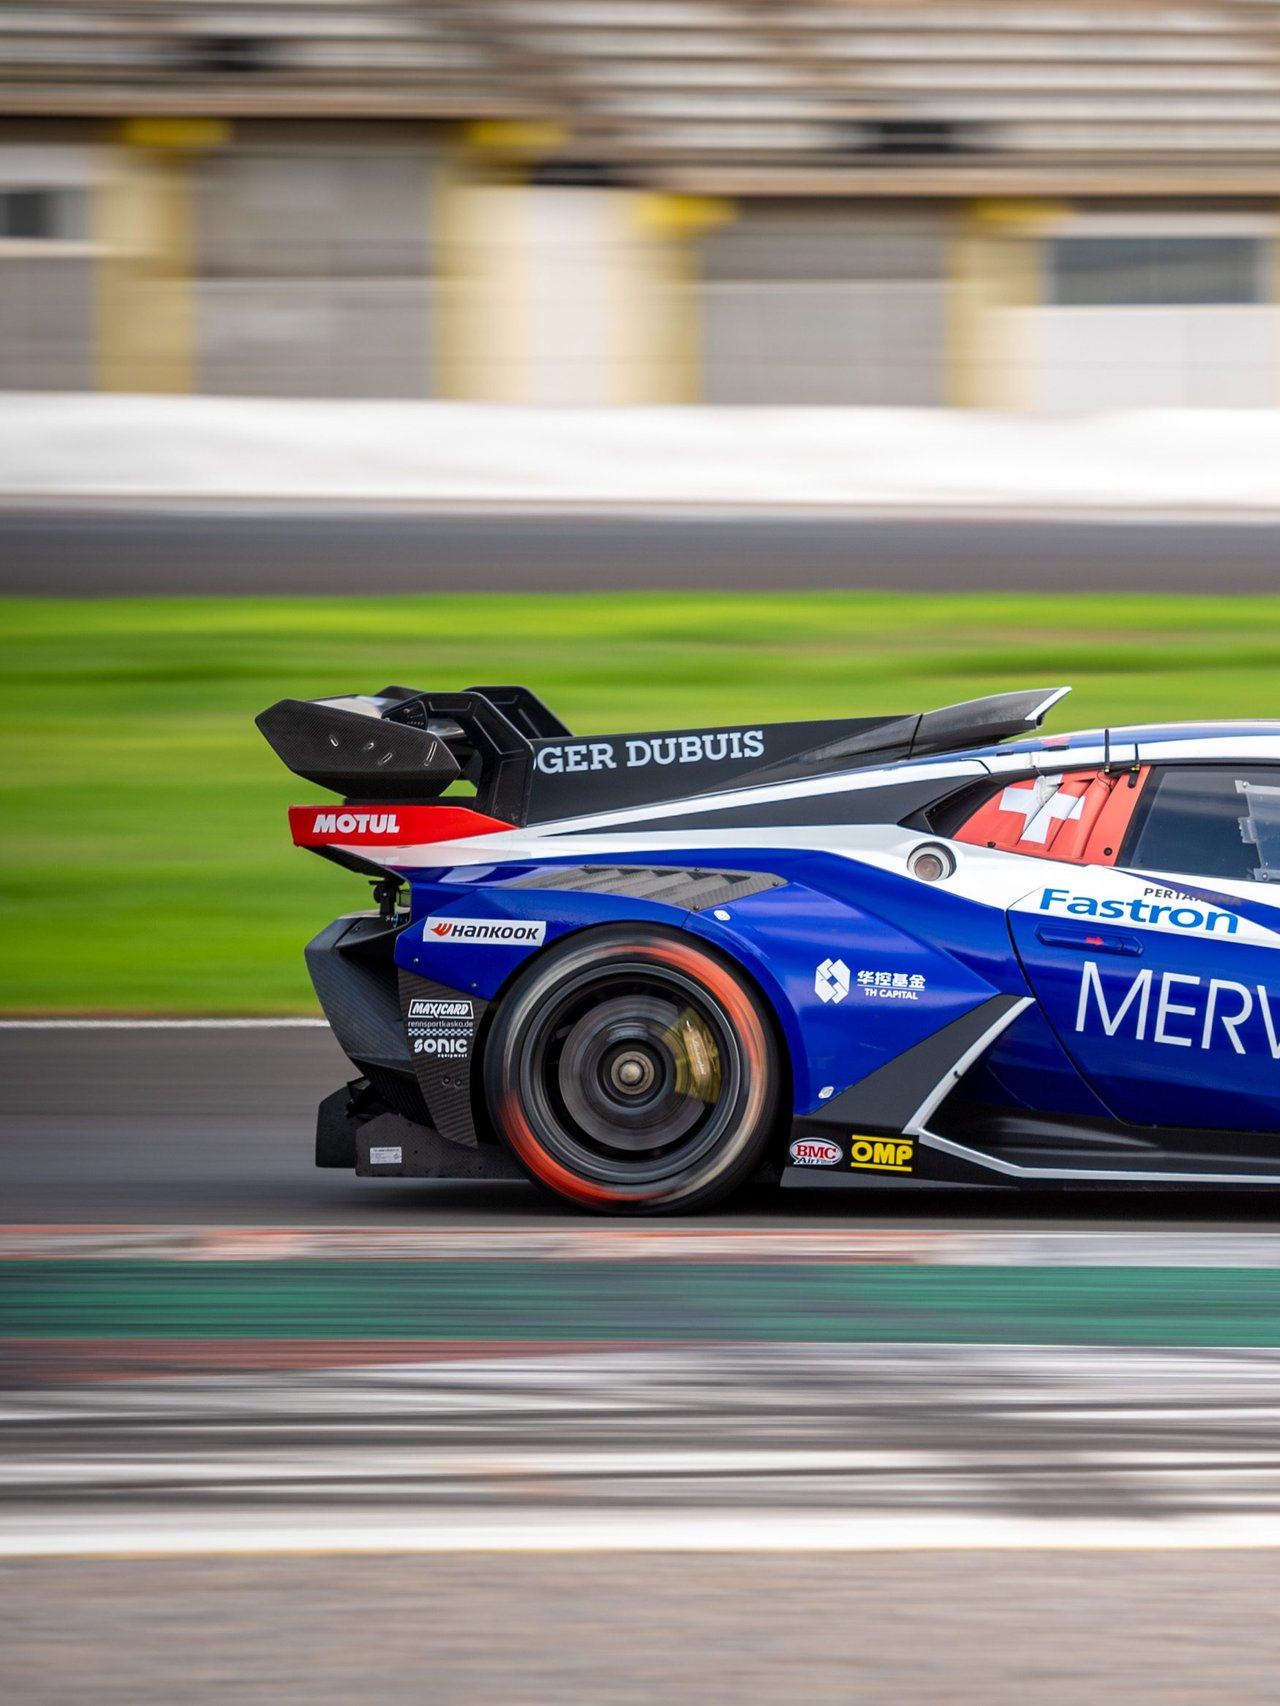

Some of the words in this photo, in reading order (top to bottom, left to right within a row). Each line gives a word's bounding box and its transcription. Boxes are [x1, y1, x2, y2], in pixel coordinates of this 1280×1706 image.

[534, 743, 617, 774] GER
[625, 730, 765, 767] DUBUIS
[312, 813, 400, 834] MOTUL
[1039, 888, 1239, 934] Fastron
[857, 970, 926, 989] 华控基金
[864, 988, 877, 997] TH
[879, 989, 918, 1000] CAPITAL
[412, 1002, 469, 1018] MAXICARD
[408, 1020, 474, 1029] rennsportkasko.de
[796, 1144, 837, 1160] BMC
[851, 1141, 913, 1165] OMP
